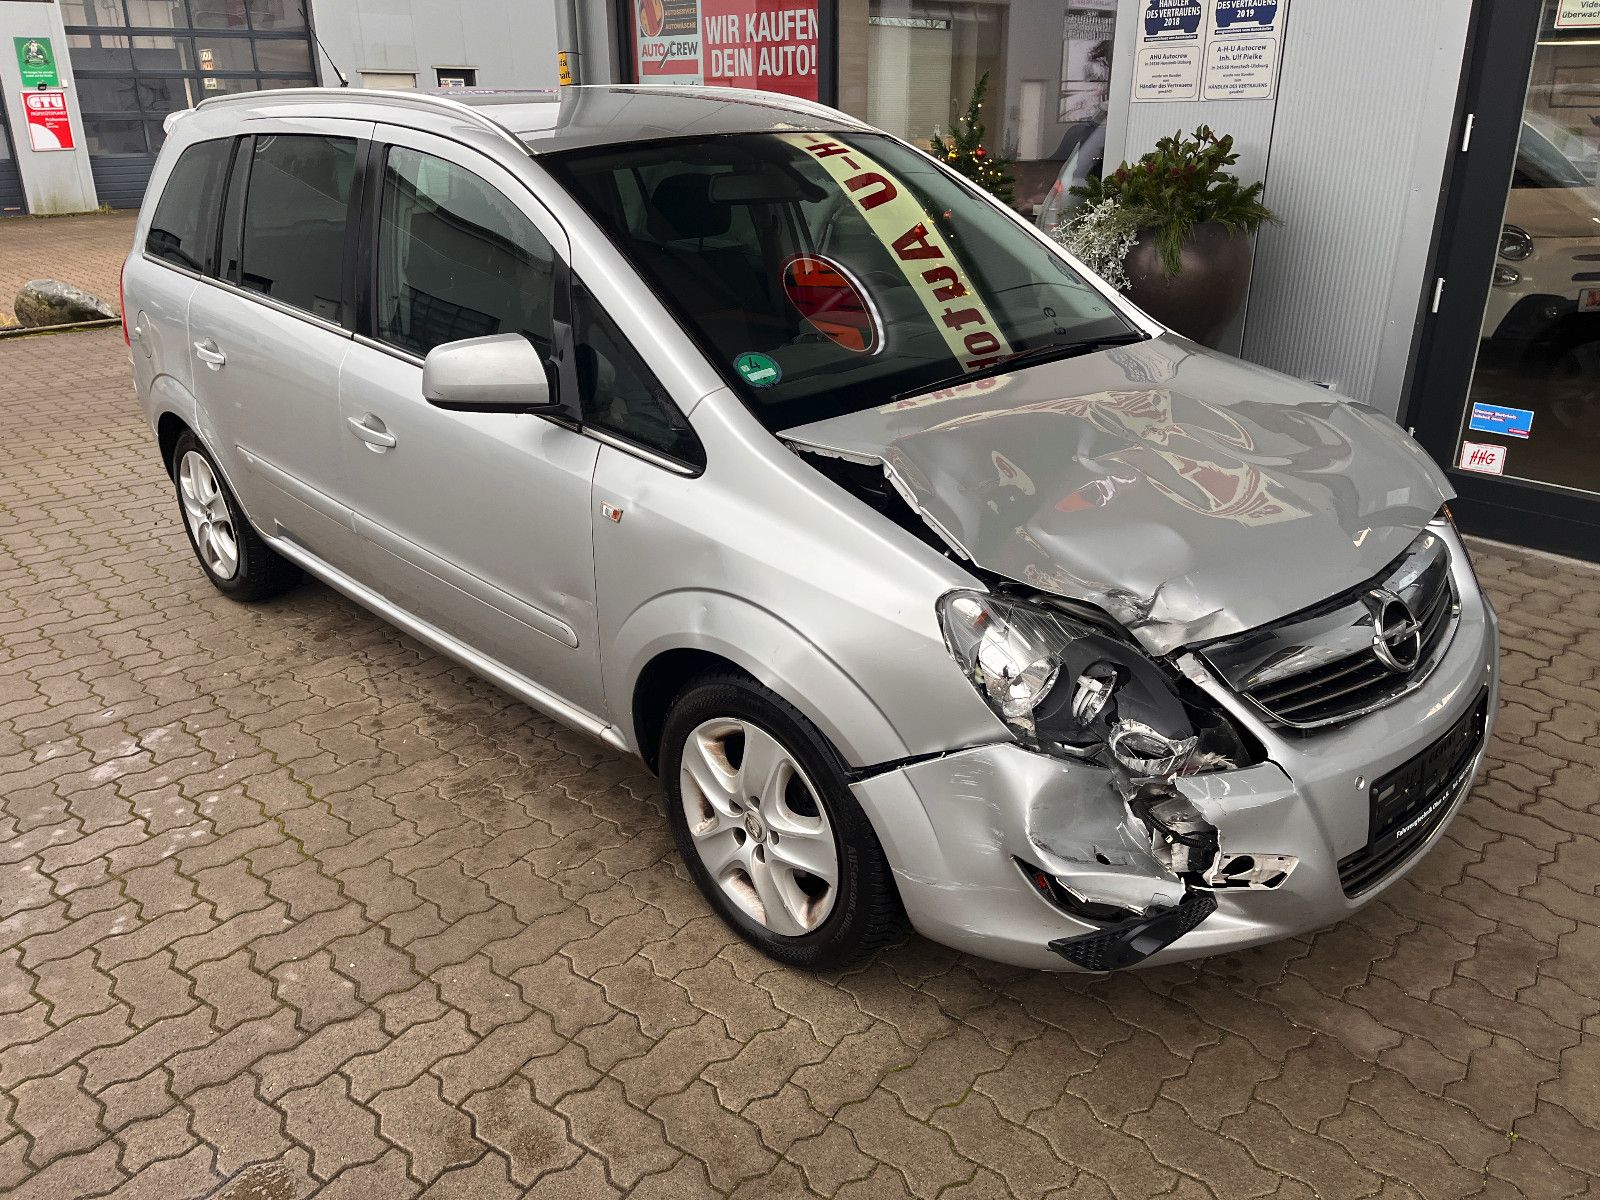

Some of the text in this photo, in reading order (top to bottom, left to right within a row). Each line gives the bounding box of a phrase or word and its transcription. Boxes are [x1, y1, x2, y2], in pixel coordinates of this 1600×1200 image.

[1217, 0, 1277, 10] DES VERTRAUENS
[1146, 6, 1201, 19] DES VERTRAUENS
[1236, 9, 1255, 18] 2019
[705, 8, 818, 45] WIR KAUFEN
[1163, 17, 1181, 27] 2018
[641, 40, 698, 58] AUTO CREW
[711, 44, 817, 77] DEIN AUTO!
[1469, 449, 1496, 465] HHG
